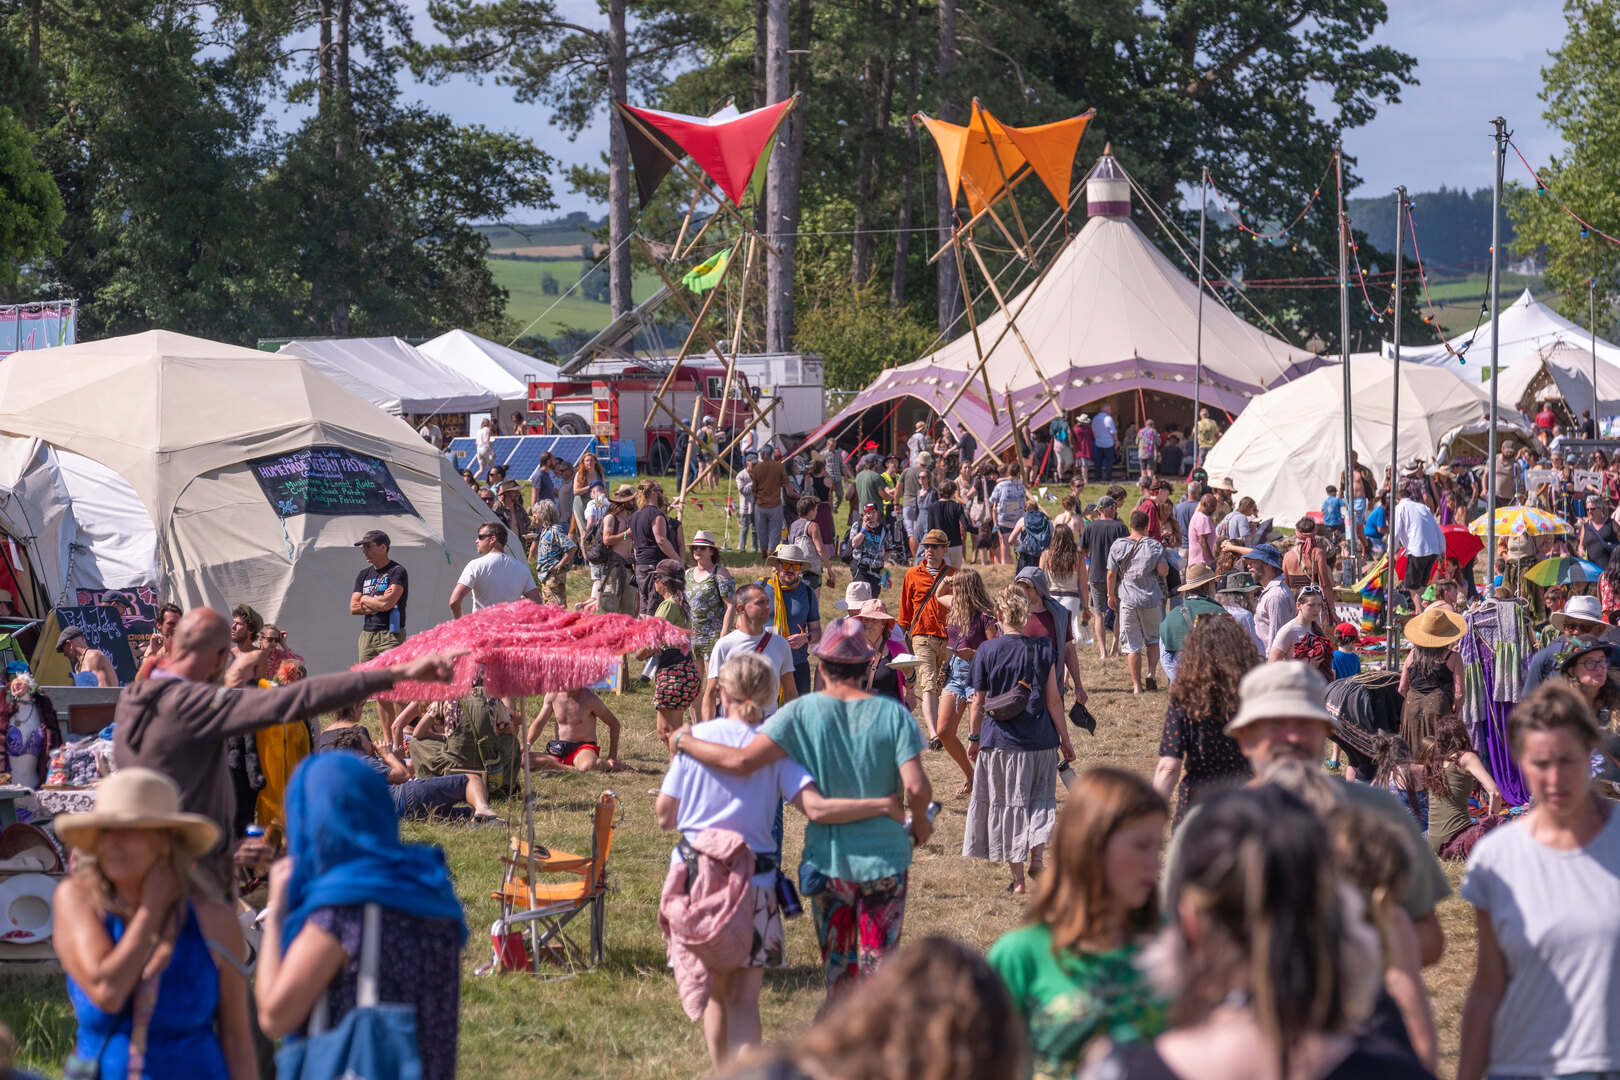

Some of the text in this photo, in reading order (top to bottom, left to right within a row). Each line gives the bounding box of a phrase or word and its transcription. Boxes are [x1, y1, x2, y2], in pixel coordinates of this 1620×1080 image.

[279, 457, 293, 465] The
[258, 460, 310, 479] HOMEMADE
[309, 458, 340, 473] VEGAN
[355, 478, 376, 489] Rolls
[342, 487, 366, 496] Potato
[338, 494, 367, 505] Pasties
